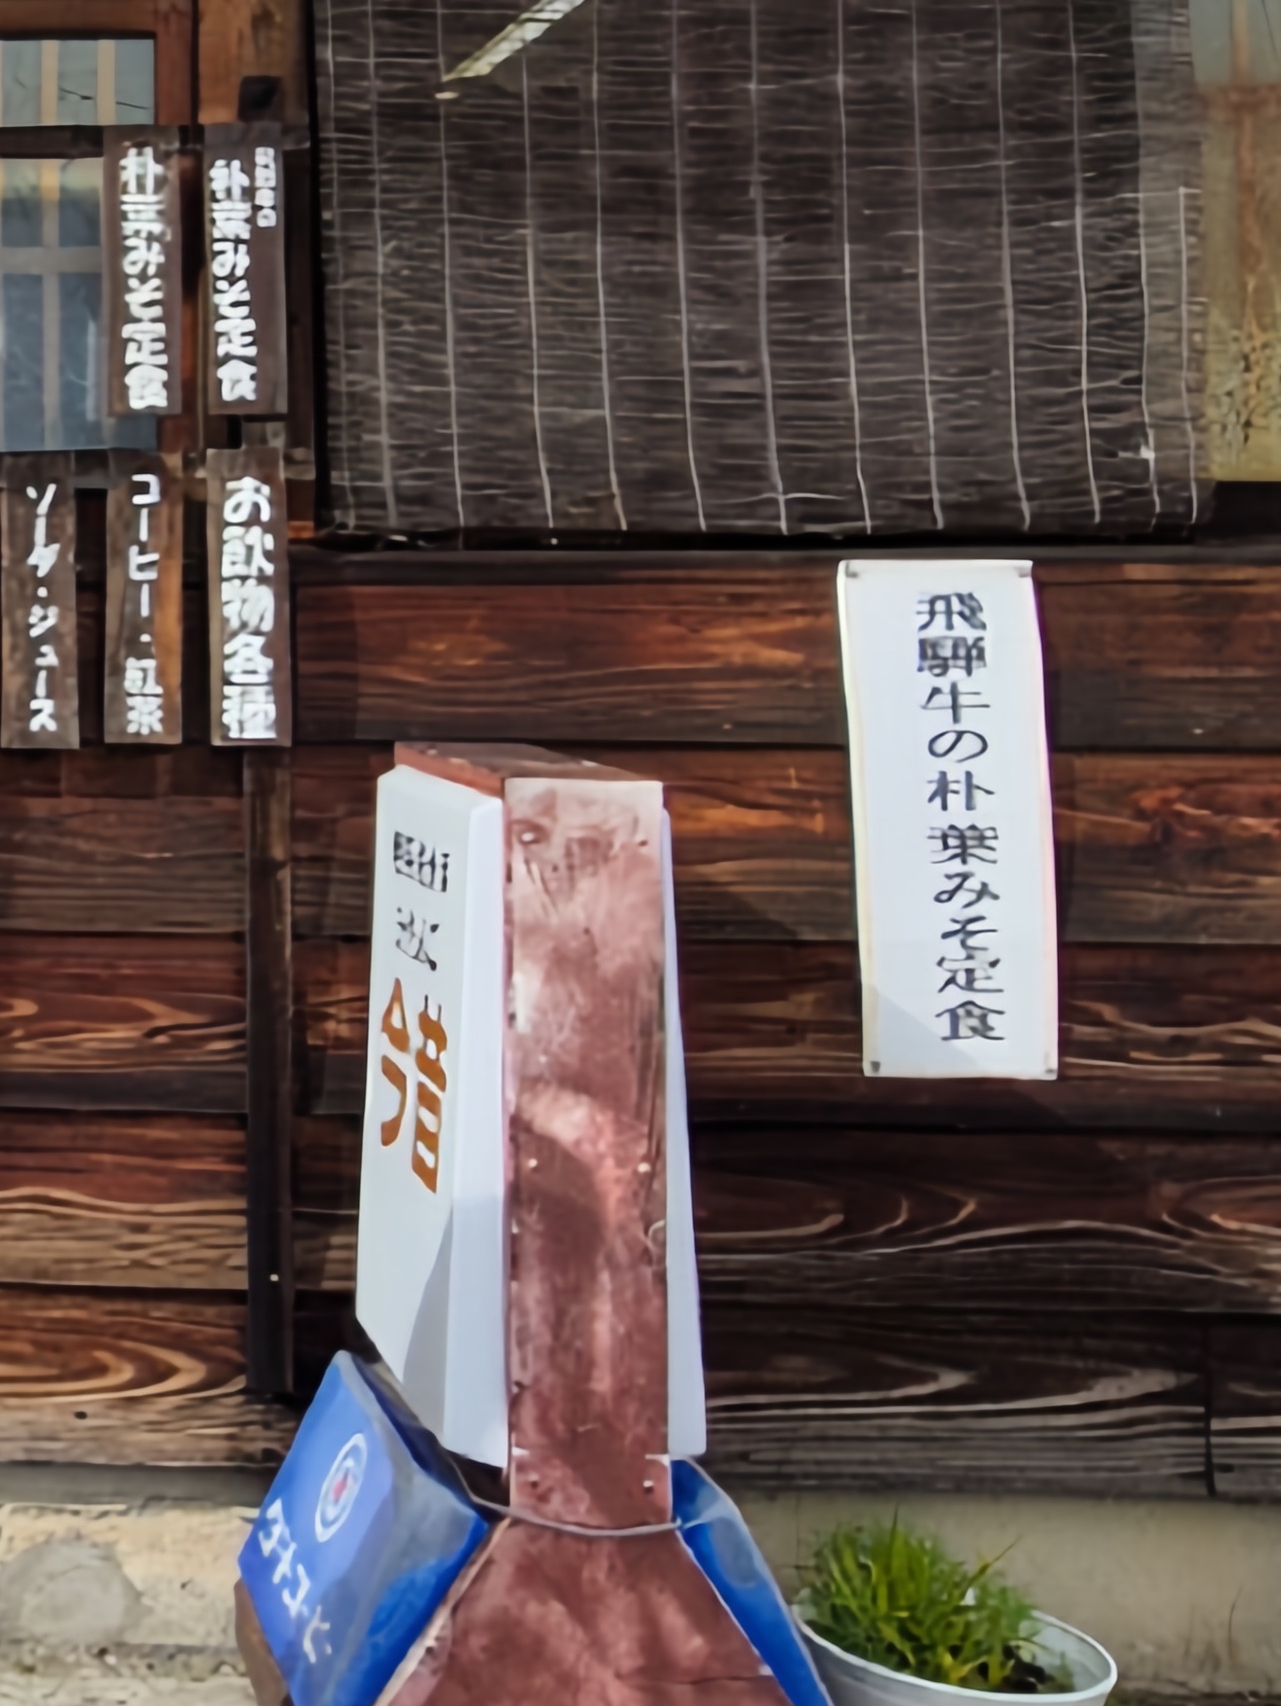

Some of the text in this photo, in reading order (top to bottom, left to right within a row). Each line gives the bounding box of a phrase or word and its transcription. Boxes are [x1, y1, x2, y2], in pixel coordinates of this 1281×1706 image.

[26, 483, 61, 733] ソーダ・ジュース
[123, 473, 164, 736] コーヒー・紅茶
[221, 476, 277, 740] お飲物各種
[916, 591, 1006, 1042] 飛騨牛の朴葉みそ定食
